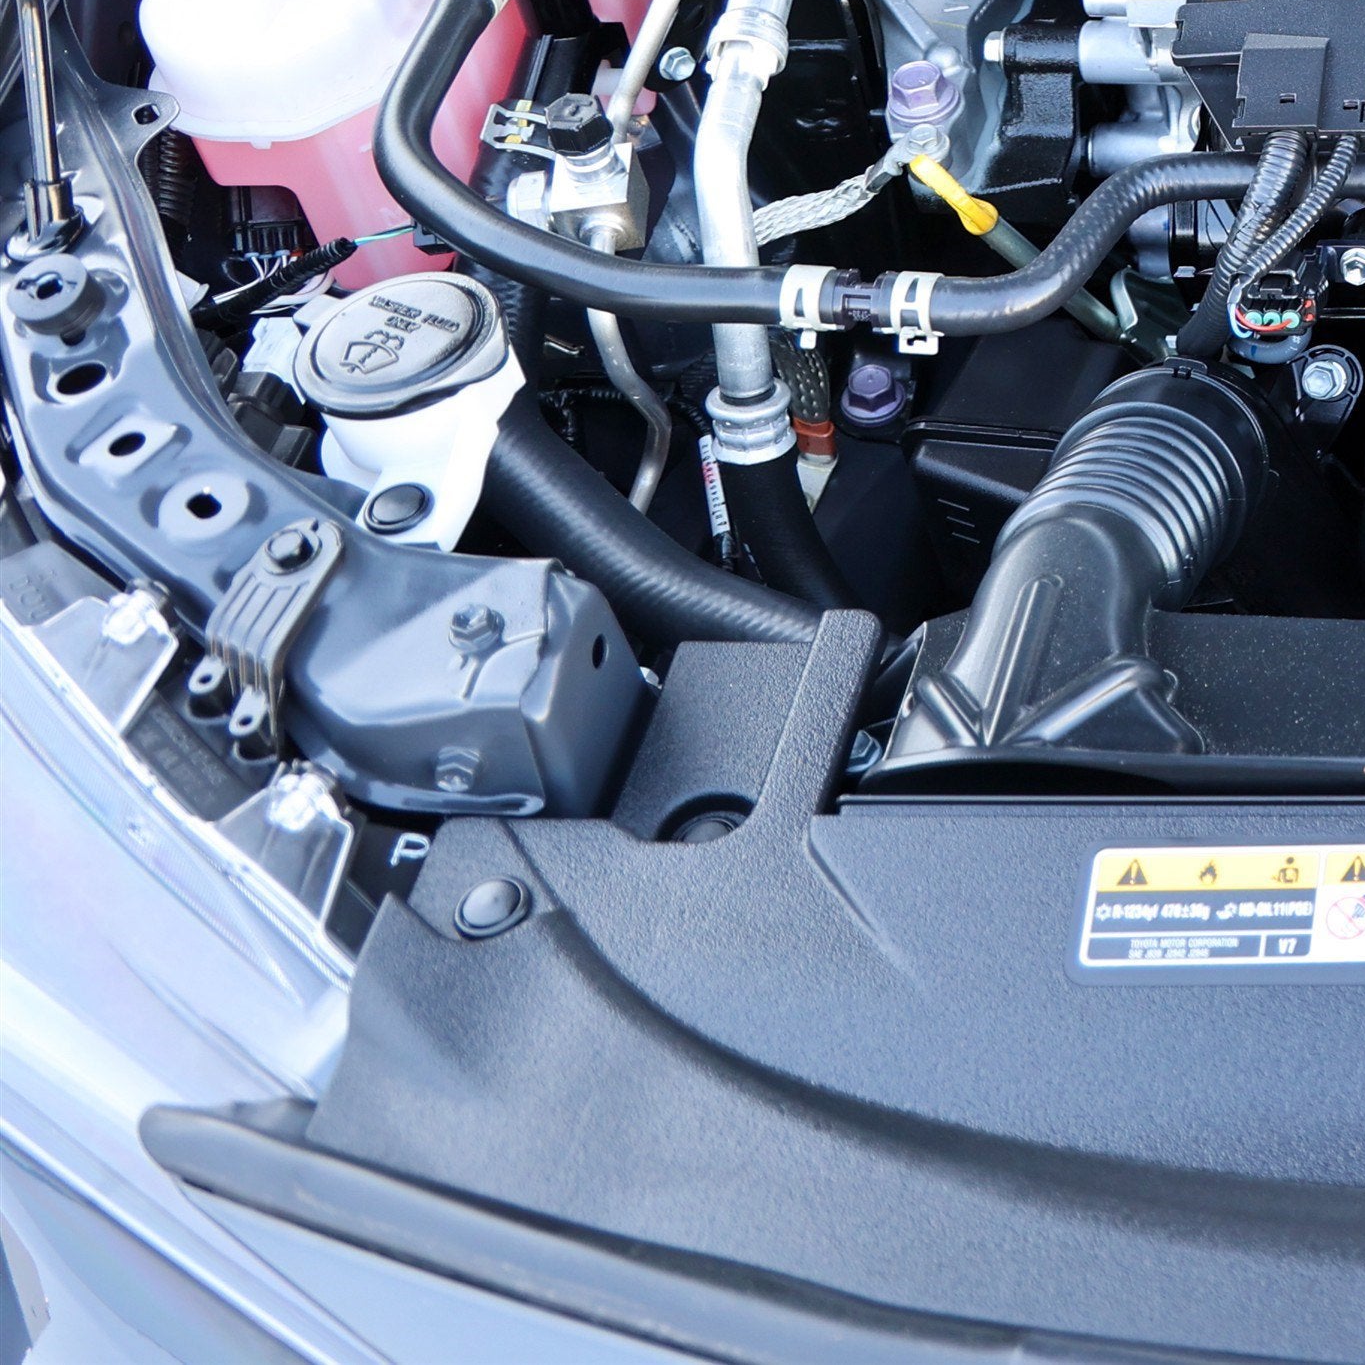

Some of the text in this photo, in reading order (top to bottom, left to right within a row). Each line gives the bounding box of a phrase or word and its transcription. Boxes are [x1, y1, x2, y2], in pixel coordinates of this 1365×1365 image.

[368, 294, 460, 333] WASHER FLUID
[384, 315, 423, 333] ONLY
[389, 833, 431, 867] P
[1130, 938, 1158, 948] TOYOTA
[1160, 938, 1186, 948] MOTOR
[1188, 937, 1239, 948] CORPORATION
